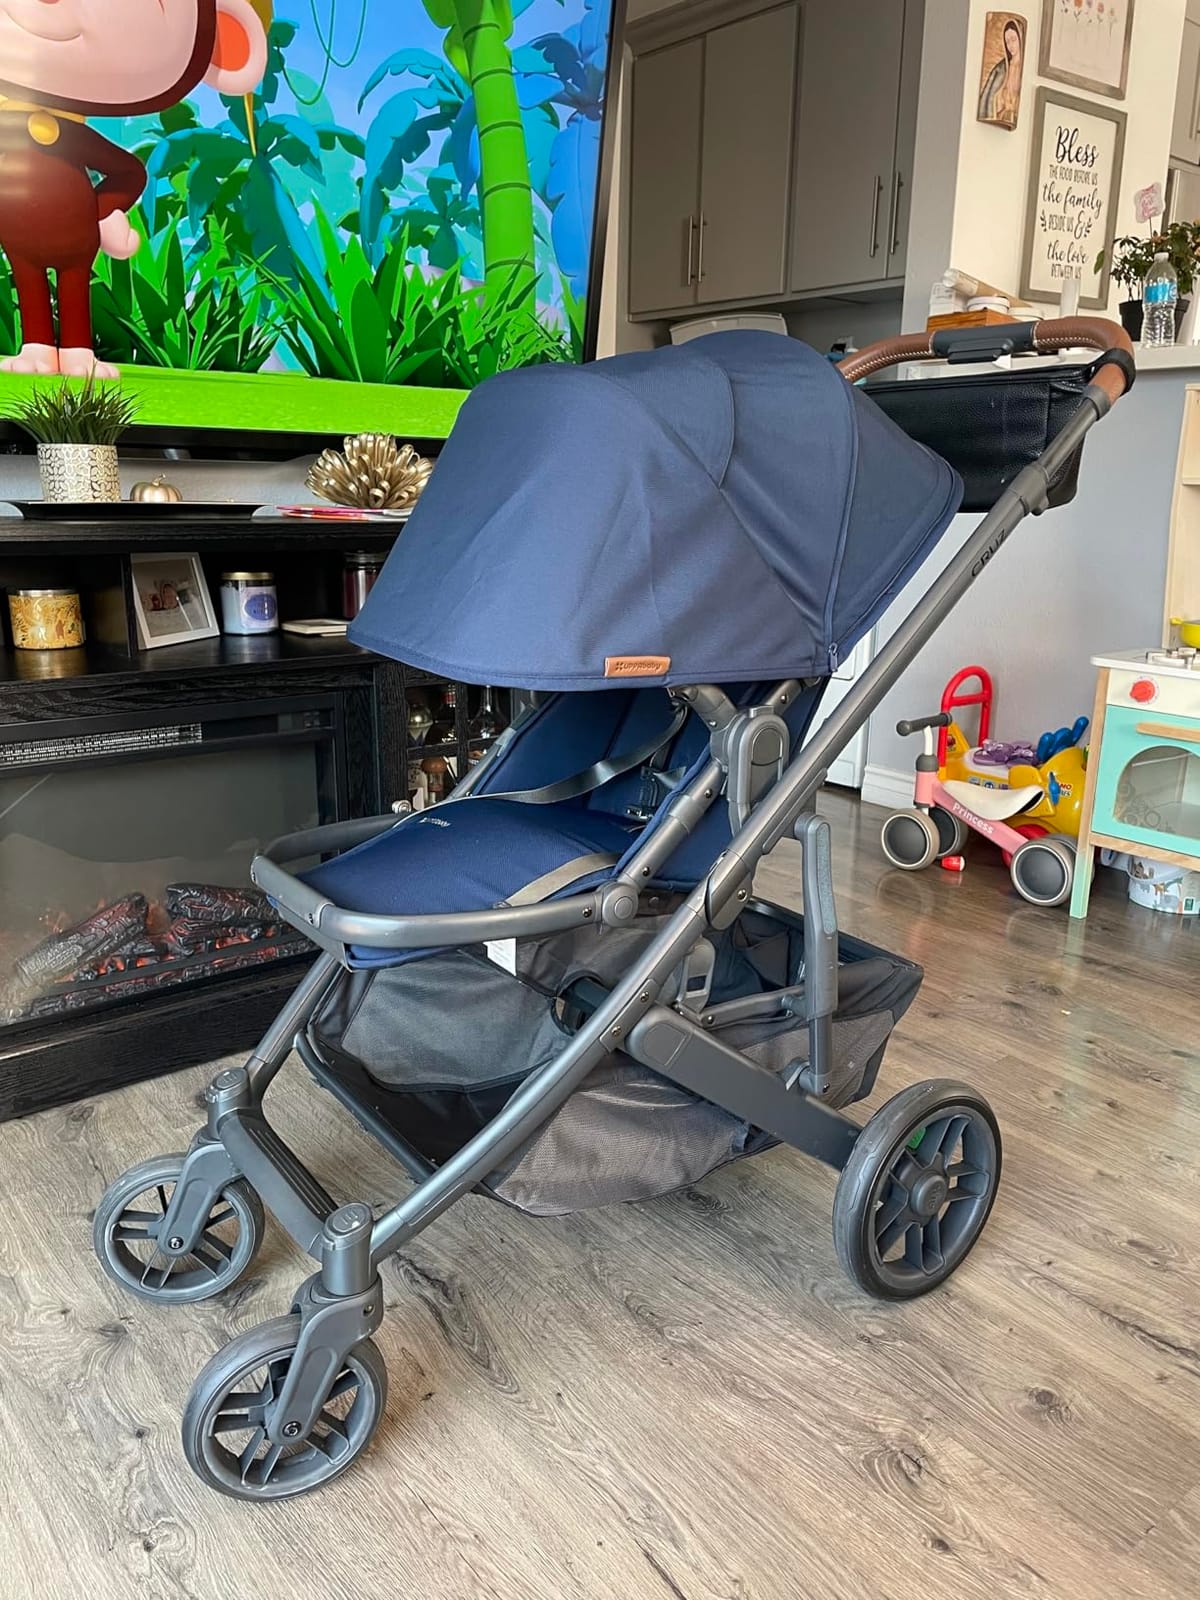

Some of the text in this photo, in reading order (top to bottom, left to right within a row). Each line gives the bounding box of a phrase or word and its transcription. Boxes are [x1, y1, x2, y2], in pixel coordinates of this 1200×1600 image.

[1055, 125, 1099, 168] Bless
[1049, 164, 1098, 186] THE FOOD BEFORE US
[1043, 181, 1101, 219] the family
[1048, 210, 1086, 239] BESIDE US &
[1047, 239, 1088, 264] the love
[1051, 263, 1073, 280] BETWEEN
[972, 529, 1007, 577] CRUZ
[952, 801, 994, 834] Princess
